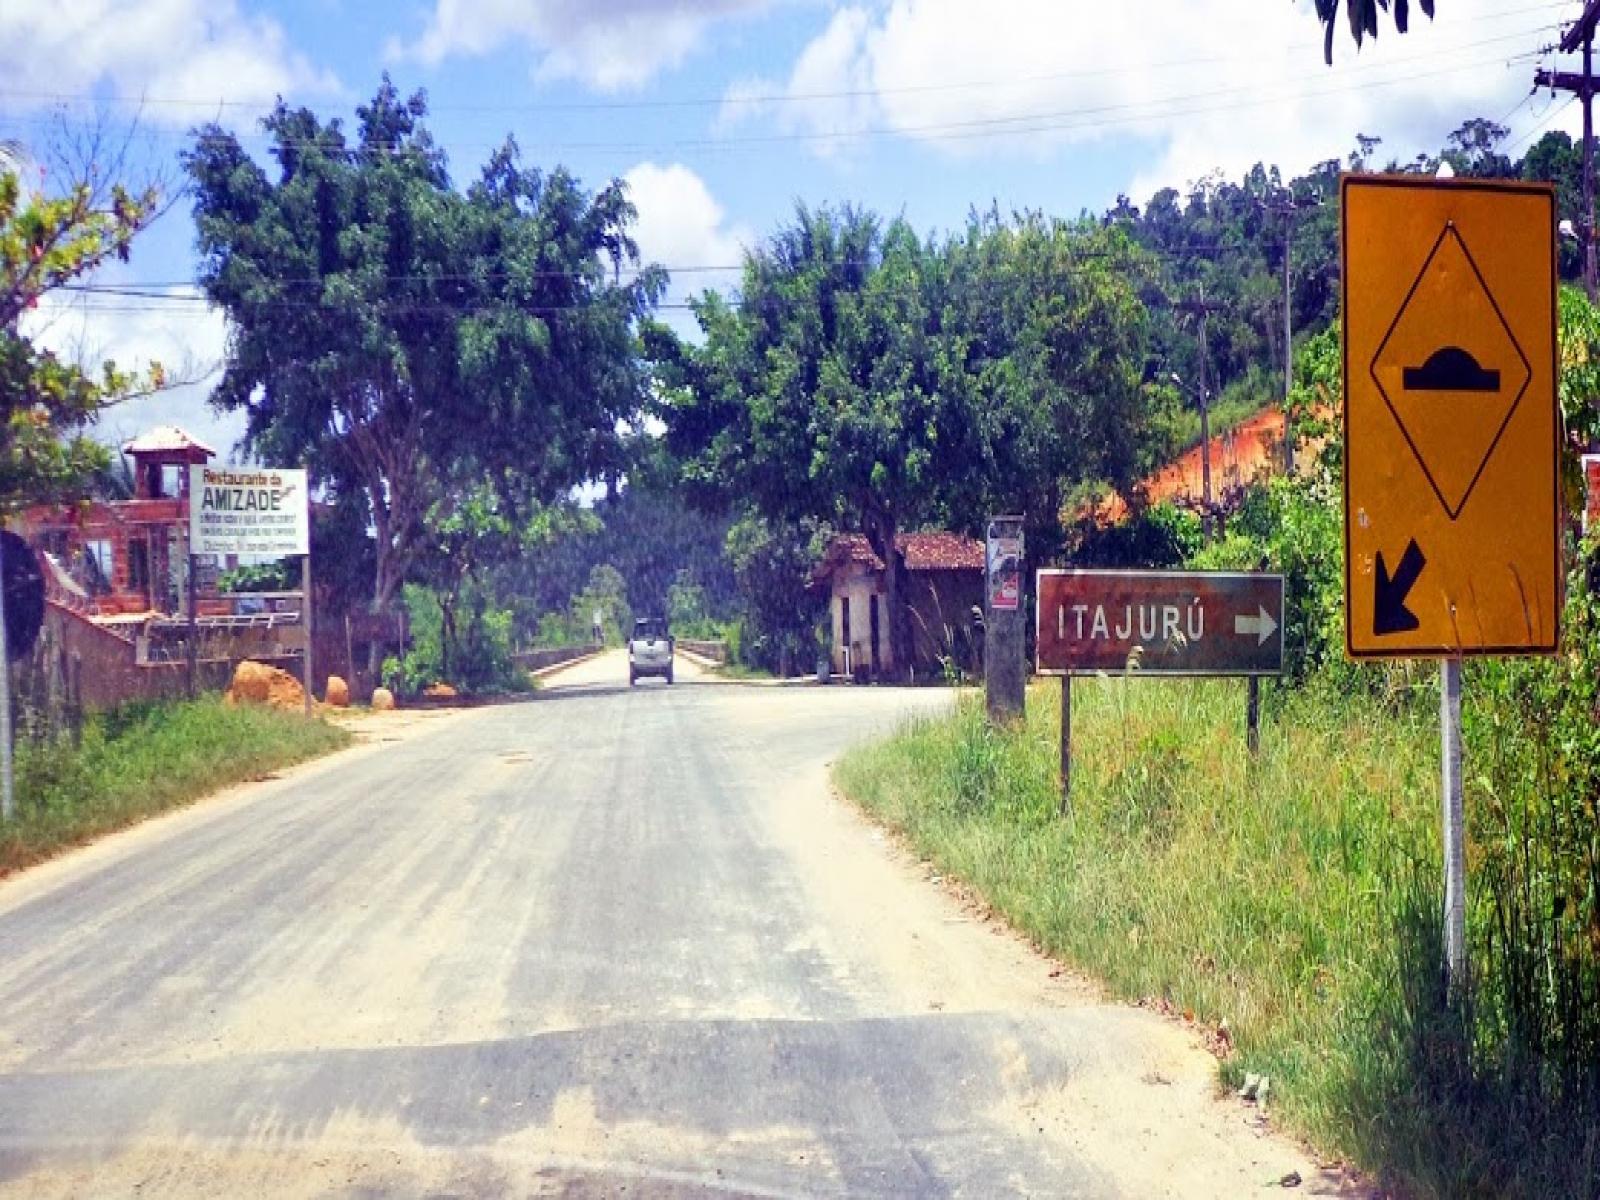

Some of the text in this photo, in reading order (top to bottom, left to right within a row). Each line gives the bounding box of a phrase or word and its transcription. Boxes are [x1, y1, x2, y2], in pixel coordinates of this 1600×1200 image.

[203, 469, 268, 485] Restaurante
[202, 487, 281, 511] AMIZADE
[1058, 597, 1204, 640] ITAJURÚ
